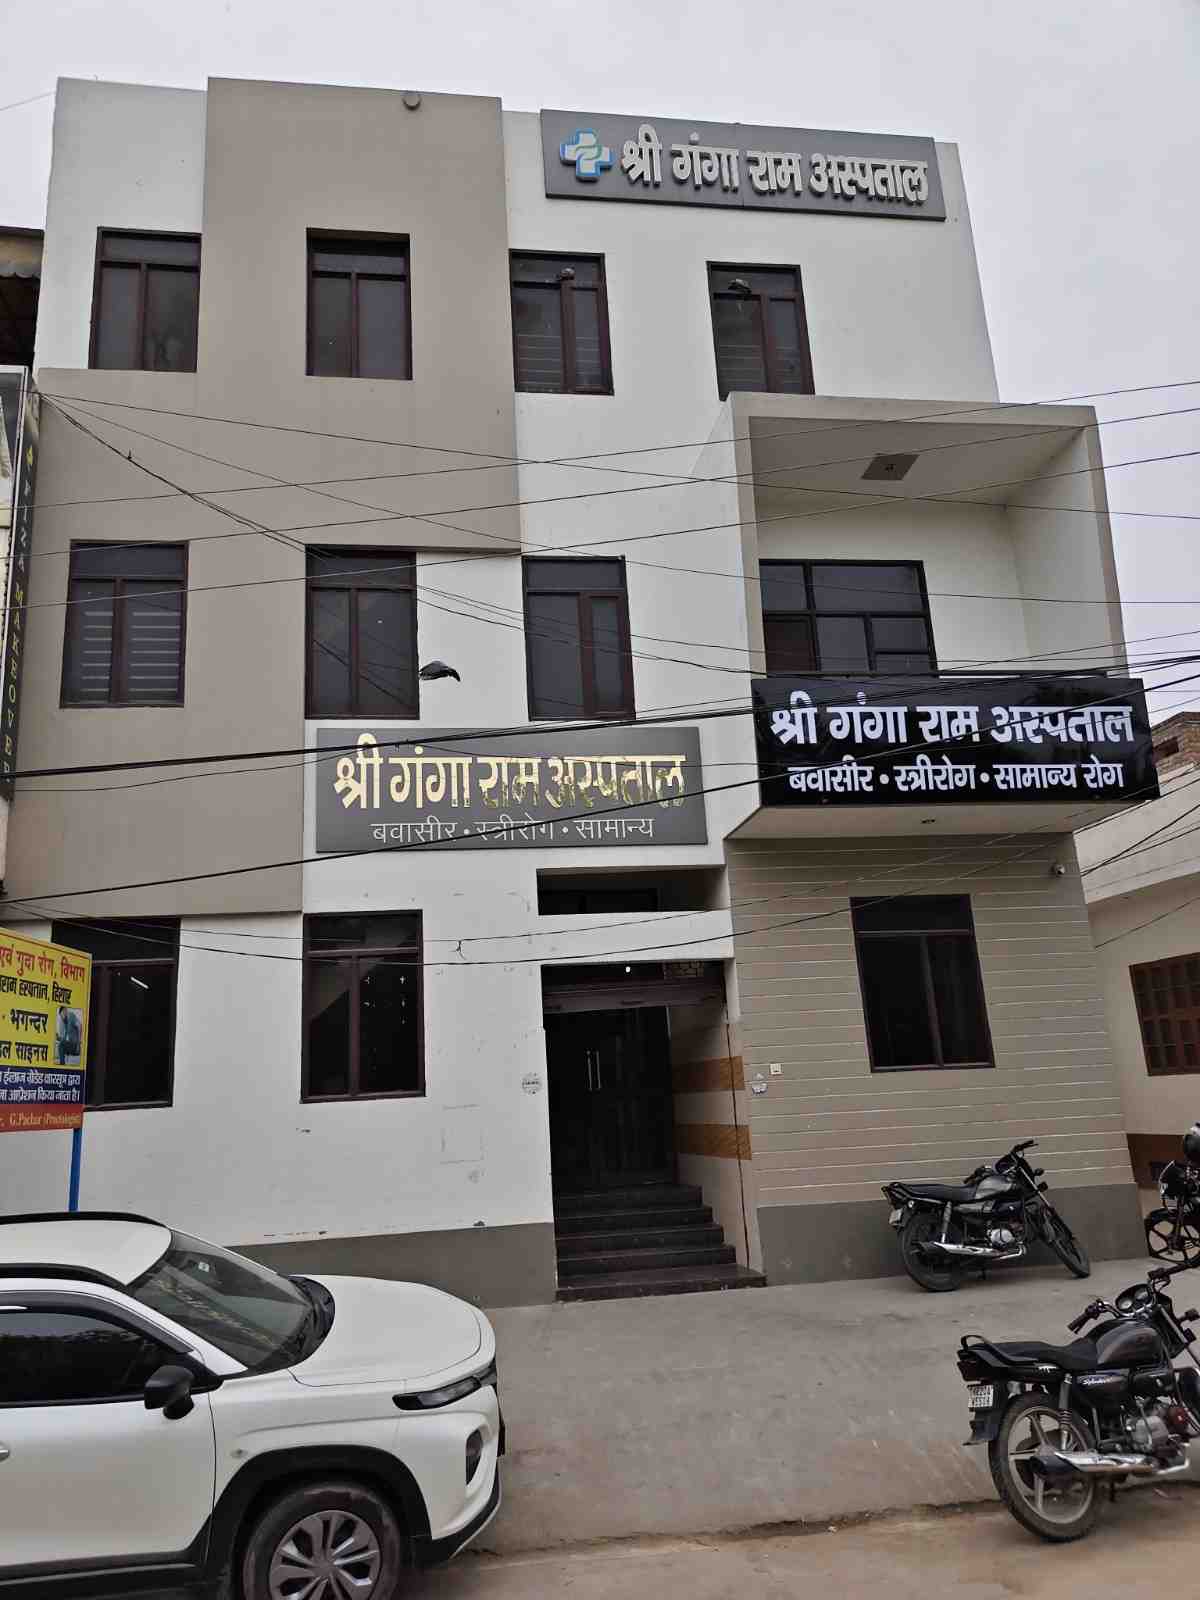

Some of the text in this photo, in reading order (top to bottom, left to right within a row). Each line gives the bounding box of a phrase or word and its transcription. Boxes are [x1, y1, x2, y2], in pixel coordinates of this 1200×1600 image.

[620, 123, 929, 206] श्री गंगा राम अस्पताल
[770, 689, 1135, 744] श्री गंगा राम अस्पताल
[334, 733, 687, 809] श्री गंगा राम अस्पताल
[787, 753, 1125, 793] बवासीर स्त्रीरोग सामान्य रोग
[368, 812, 656, 844] बवासीर स्त्रीरोग सामान्य
[10, 1008, 48, 1033] भगन्दर
[15, 1041, 48, 1064] साइनस
